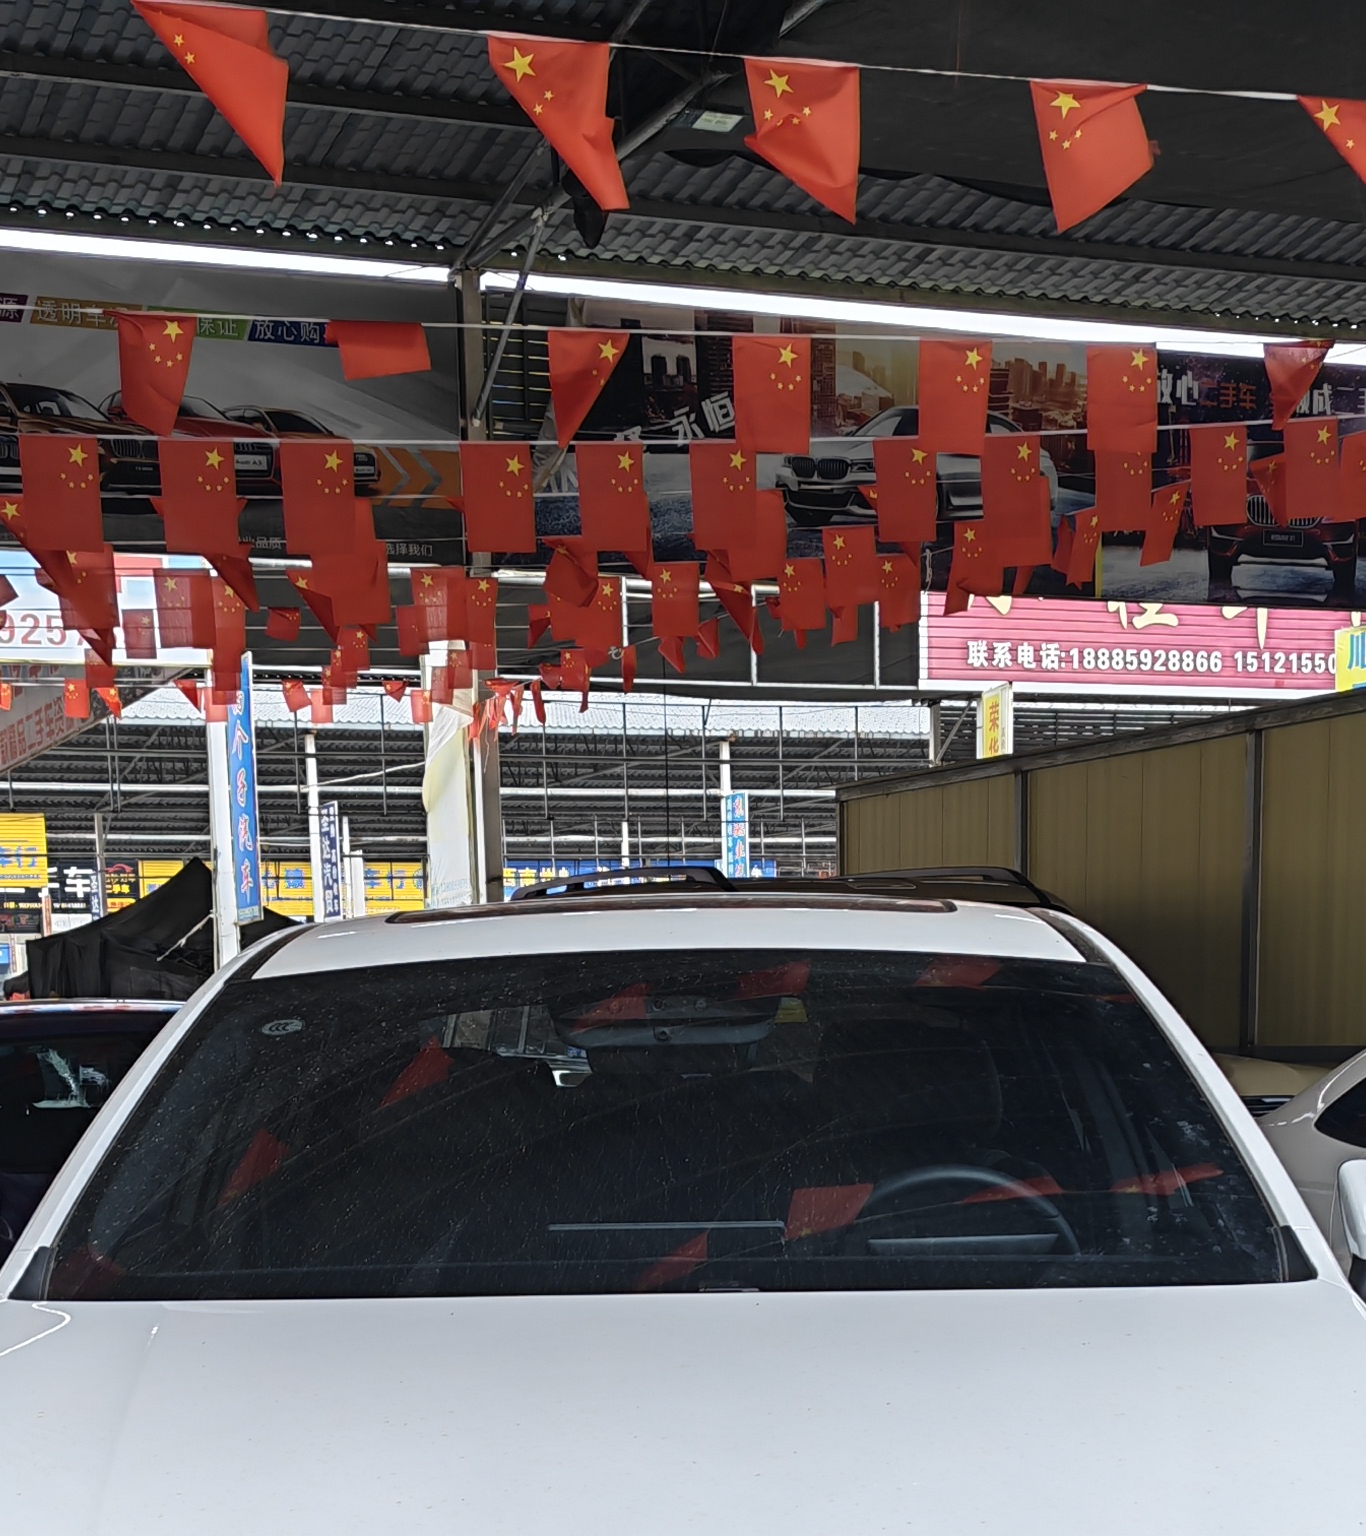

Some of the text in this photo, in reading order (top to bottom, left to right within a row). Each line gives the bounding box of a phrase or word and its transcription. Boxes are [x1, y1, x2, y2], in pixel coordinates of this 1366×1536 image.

[36, 299, 119, 327] 透明车
[254, 319, 330, 344] 放心购
